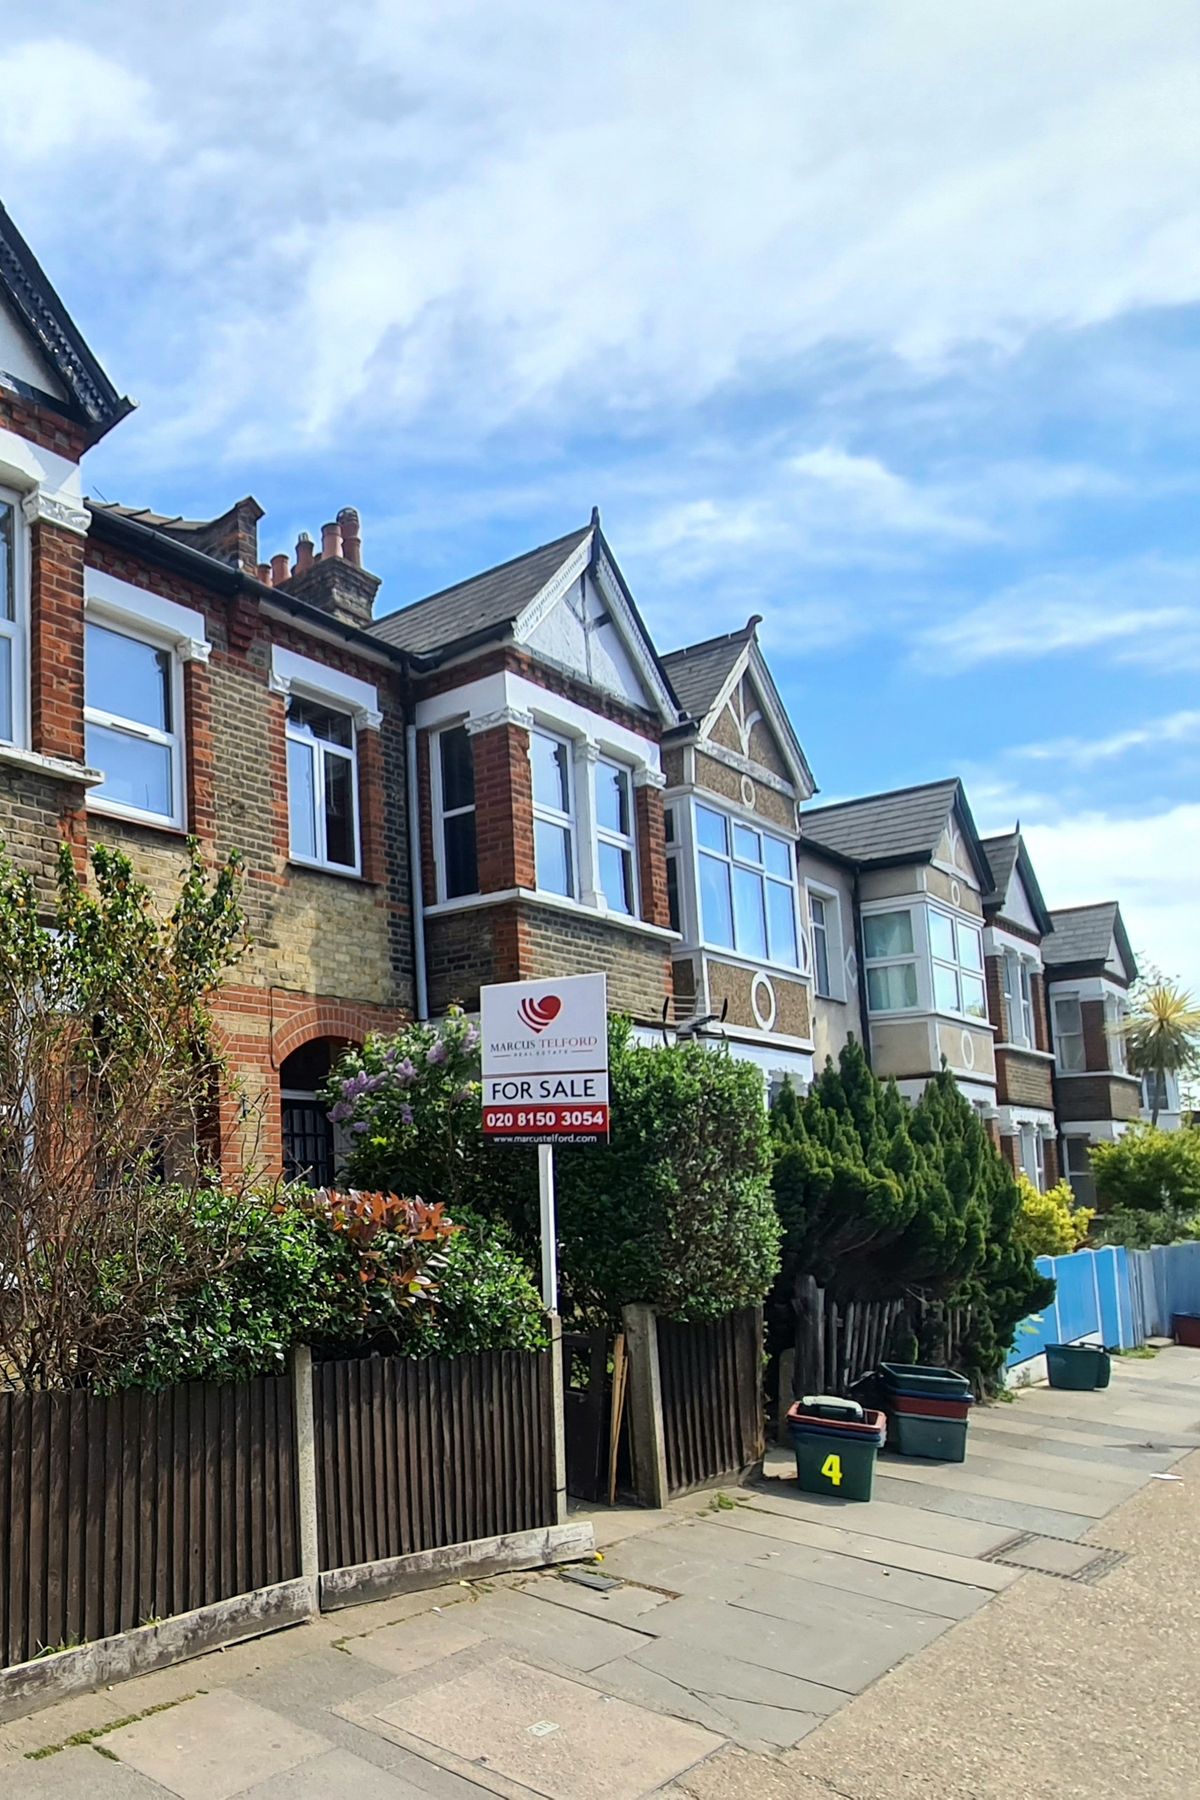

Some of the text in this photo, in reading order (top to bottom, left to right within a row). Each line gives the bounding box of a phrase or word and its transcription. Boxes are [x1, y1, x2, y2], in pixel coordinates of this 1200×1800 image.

[490, 1036, 598, 1053] MARCUS TELFORD
[492, 1079, 596, 1100] FOR SALE
[486, 1110, 604, 1127] 020 8150 3054
[493, 1133, 597, 1143] www.marcustelford.com
[821, 1454, 843, 1486] 4
